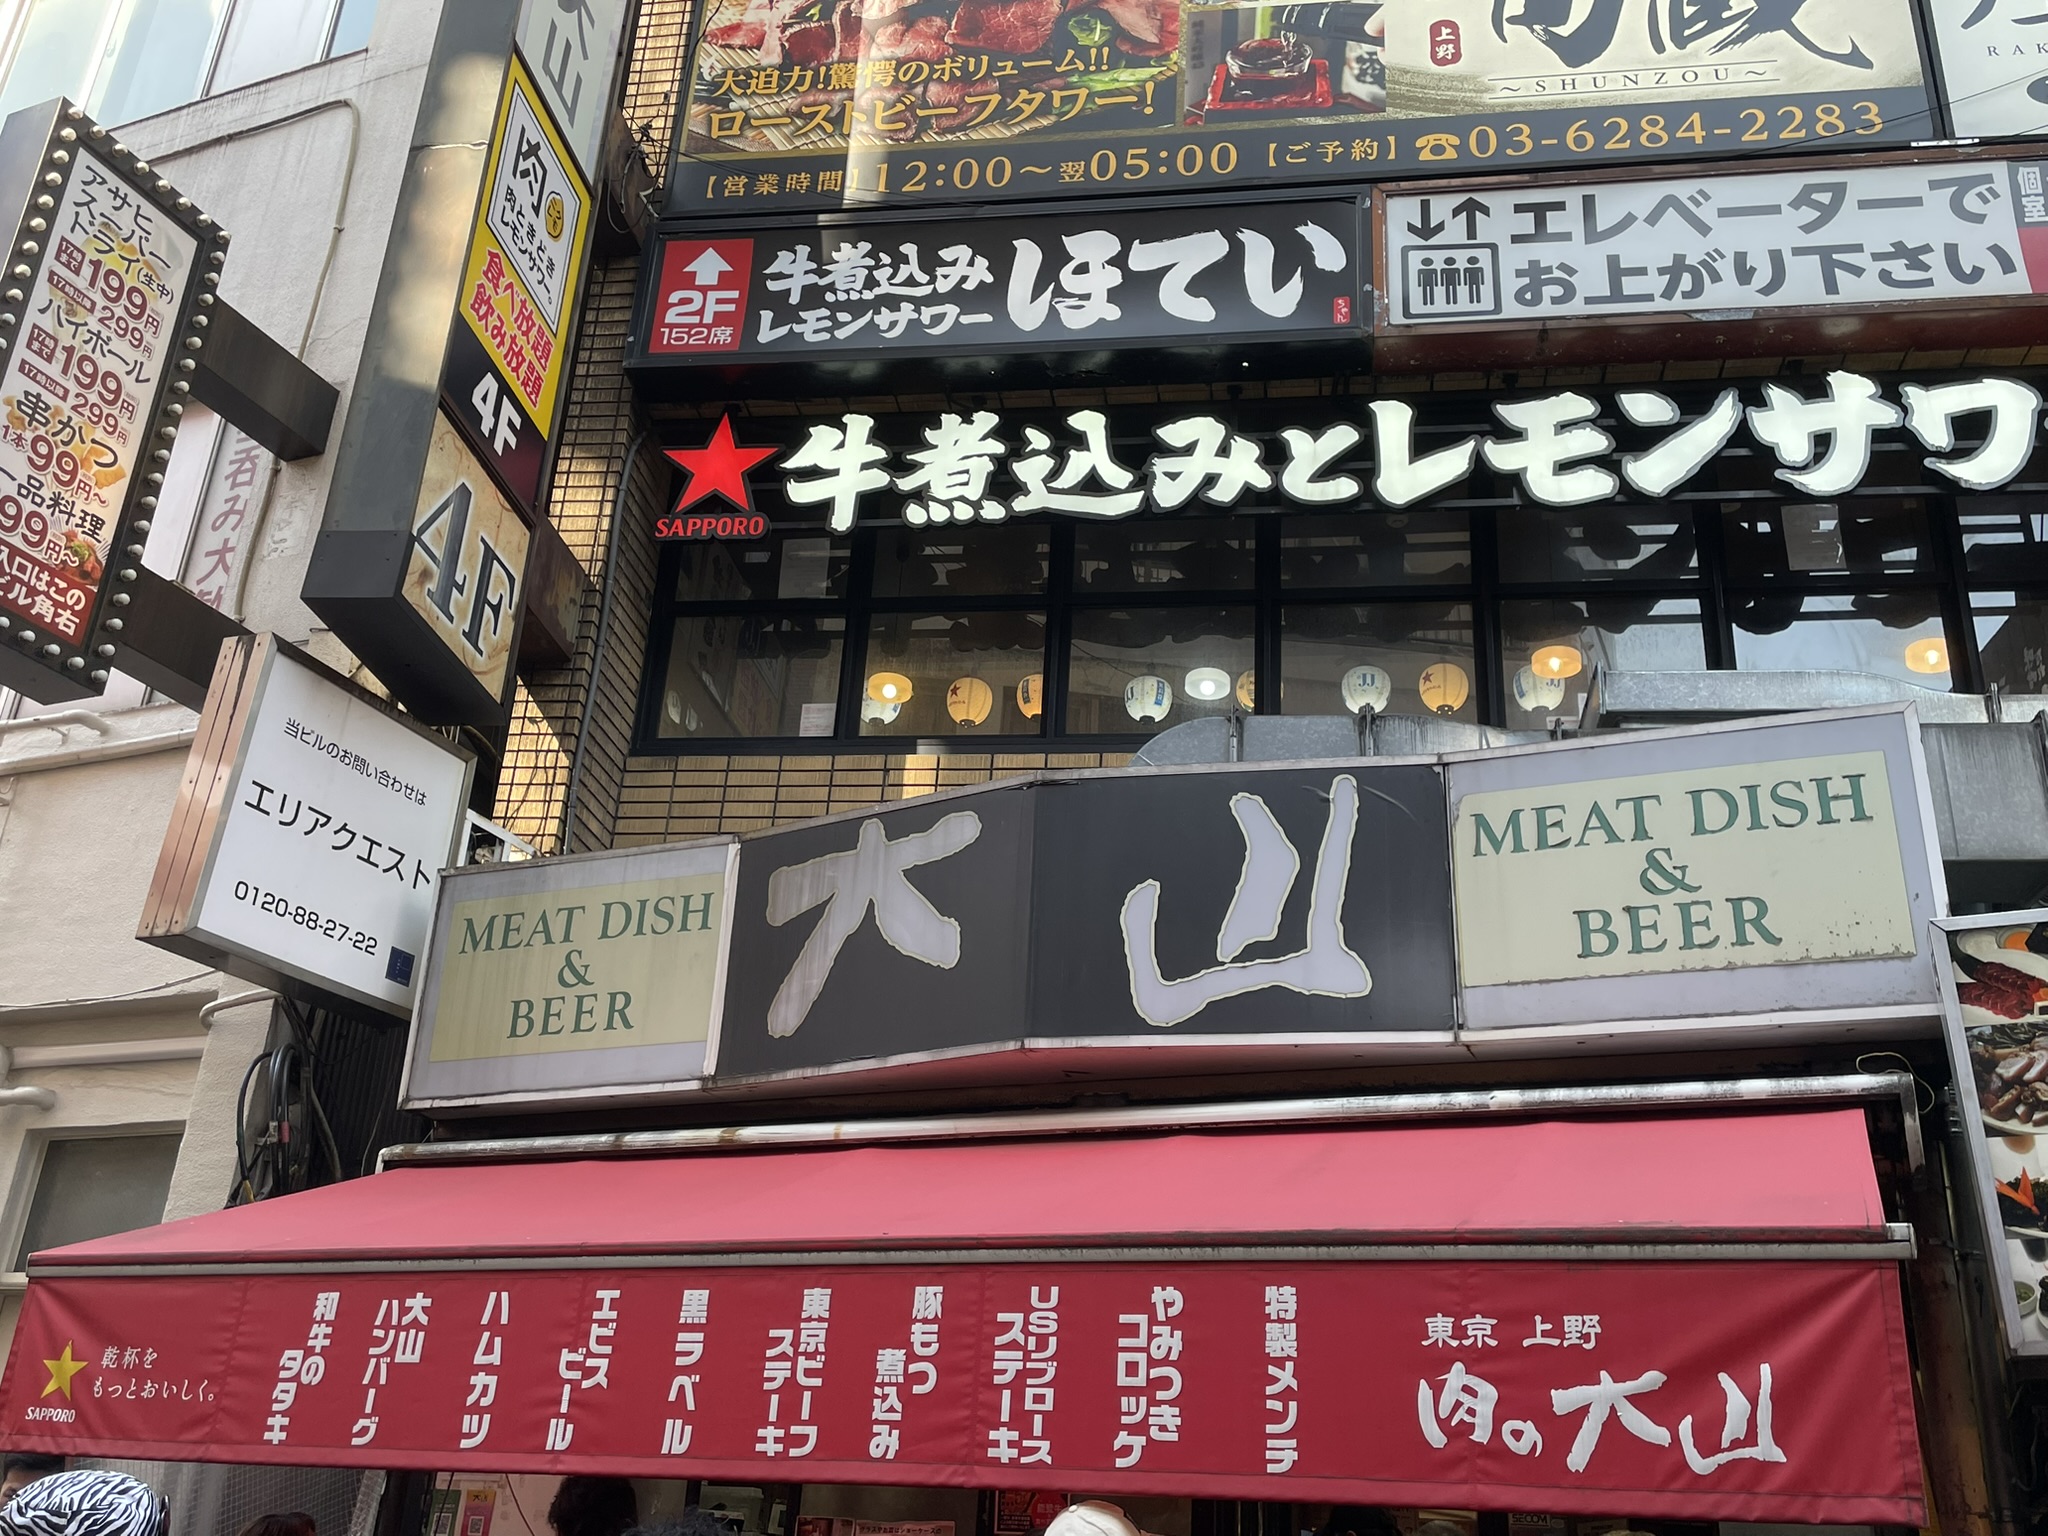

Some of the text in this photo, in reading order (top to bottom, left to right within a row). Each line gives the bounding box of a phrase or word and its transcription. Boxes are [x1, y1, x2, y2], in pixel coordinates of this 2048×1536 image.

[1434, 25, 1458, 61] 上野
[709, 80, 1156, 140] ローストビーフタワー!
[1468, 101, 1884, 158] 03-6284-2283
[81, 164, 154, 237] アサヒ
[512, 124, 548, 219] 肉
[1508, 173, 2001, 245] エレベーターで
[2017, 166, 2048, 223] 個室
[59, 252, 79, 270] まで
[73, 188, 172, 269] スーパー
[52, 275, 92, 311] 17時以降
[88, 258, 161, 336] 199円
[482, 249, 554, 372] 食べ放題
[664, 290, 740, 325] 2F
[762, 241, 994, 305] 牛煮込み
[1007, 220, 1347, 332] ほてい
[1512, 239, 2018, 308] お上がり下さい
[31, 340, 51, 359] まで
[38, 297, 151, 384] ハイボール
[98, 305, 153, 359] 299円
[470, 282, 545, 408] 飲み放題
[660, 326, 734, 346] 152席
[756, 301, 994, 345] レモンサワー
[23, 364, 65, 398] 17時以降
[61, 344, 136, 421] 199円
[70, 392, 128, 445] 299円
[471, 371, 522, 457] 4F
[16, 390, 119, 468] 串かつ
[779, 371, 2038, 533] 牛煮込みとレモンサワ
[655, 516, 765, 539] SAPPORO
[412, 481, 517, 658] 4F
[284, 717, 428, 807] 当ビルのお問い合わせは
[244, 779, 432, 890] エリアクエスト
[1470, 773, 1874, 858] MEAT DISH
[766, 773, 1373, 1039] 大山
[1639, 847, 1702, 896] &
[234, 881, 379, 956] 0120-88-27-22
[458, 892, 715, 955] MEAT DISH
[1572, 897, 1783, 959] BEER
[557, 949, 595, 989] &
[507, 990, 635, 1039] BEER
[101, 1346, 158, 1370] 乾杯を
[300, 1291, 340, 1386] 和牛の
[394, 1292, 432, 1363] 大山
[581, 1289, 621, 1390] エビス
[907, 1286, 944, 1395] 豚もつ
[1149, 1286, 1184, 1441] やみつき
[1421, 1312, 1602, 1350] 東京 上野
[93, 1376, 215, 1402] もっとおいしく。
[263, 1350, 304, 1445] タタキ
[351, 1299, 399, 1446] ハンバーグ
[459, 1291, 509, 1449] ハムカツ
[545, 1348, 587, 1451] ビール
[661, 1289, 710, 1455] 黒ラベル
[755, 1329, 794, 1457] ステーキ
[788, 1287, 832, 1458] 東京ビーフ
[868, 1347, 907, 1460] 煮込み
[987, 1312, 1025, 1464] ステーキ
[1020, 1286, 1059, 1465] USリブロース
[1113, 1313, 1149, 1468] コロッケ
[1265, 1286, 1298, 1473] 特製メンチ
[25, 1406, 76, 1423] SAPPORO
[1417, 1360, 1787, 1475] 肉の大山
[1511, 1513, 1548, 1524] SECOM
